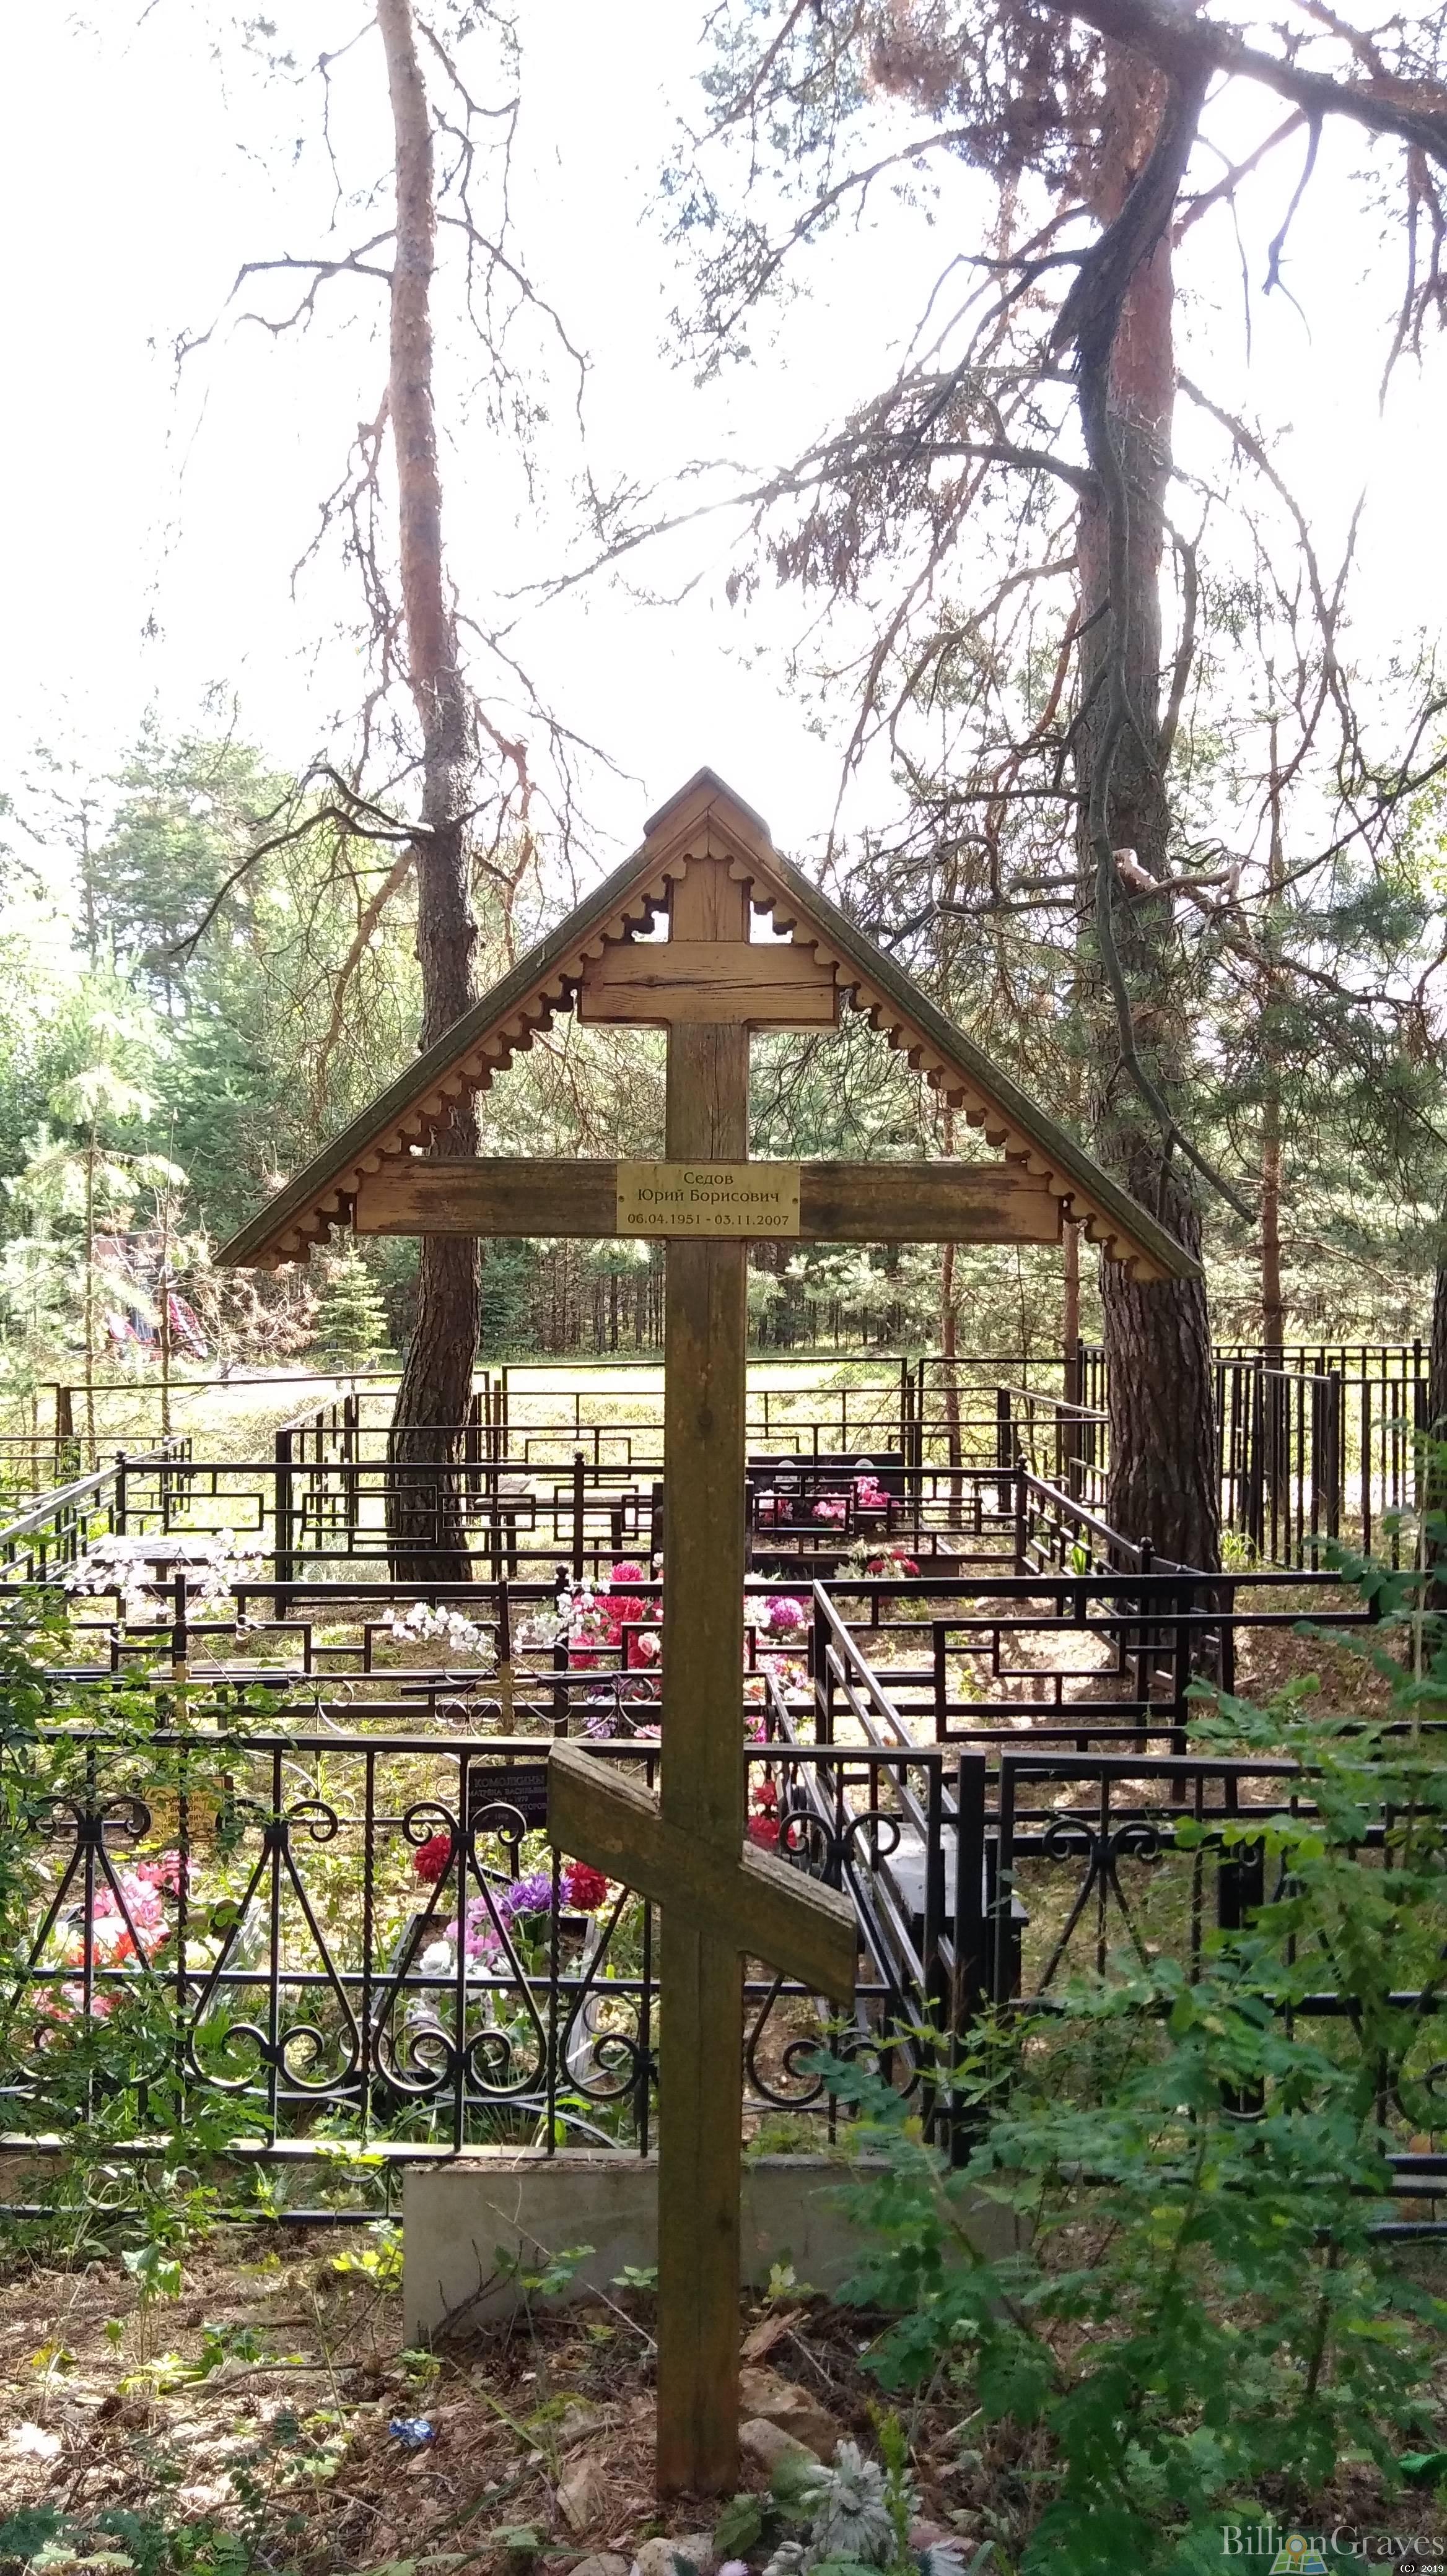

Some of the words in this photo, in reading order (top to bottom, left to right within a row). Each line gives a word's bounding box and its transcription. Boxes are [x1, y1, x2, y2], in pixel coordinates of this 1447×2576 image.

[683, 1172, 733, 1185] Седов
[638, 1188, 684, 1204] Юрий
[690, 1189, 779, 1204] Борисович
[627, 1214, 701, 1224] 06.04.1951
[714, 1214, 789, 1225] 03.11.2007
